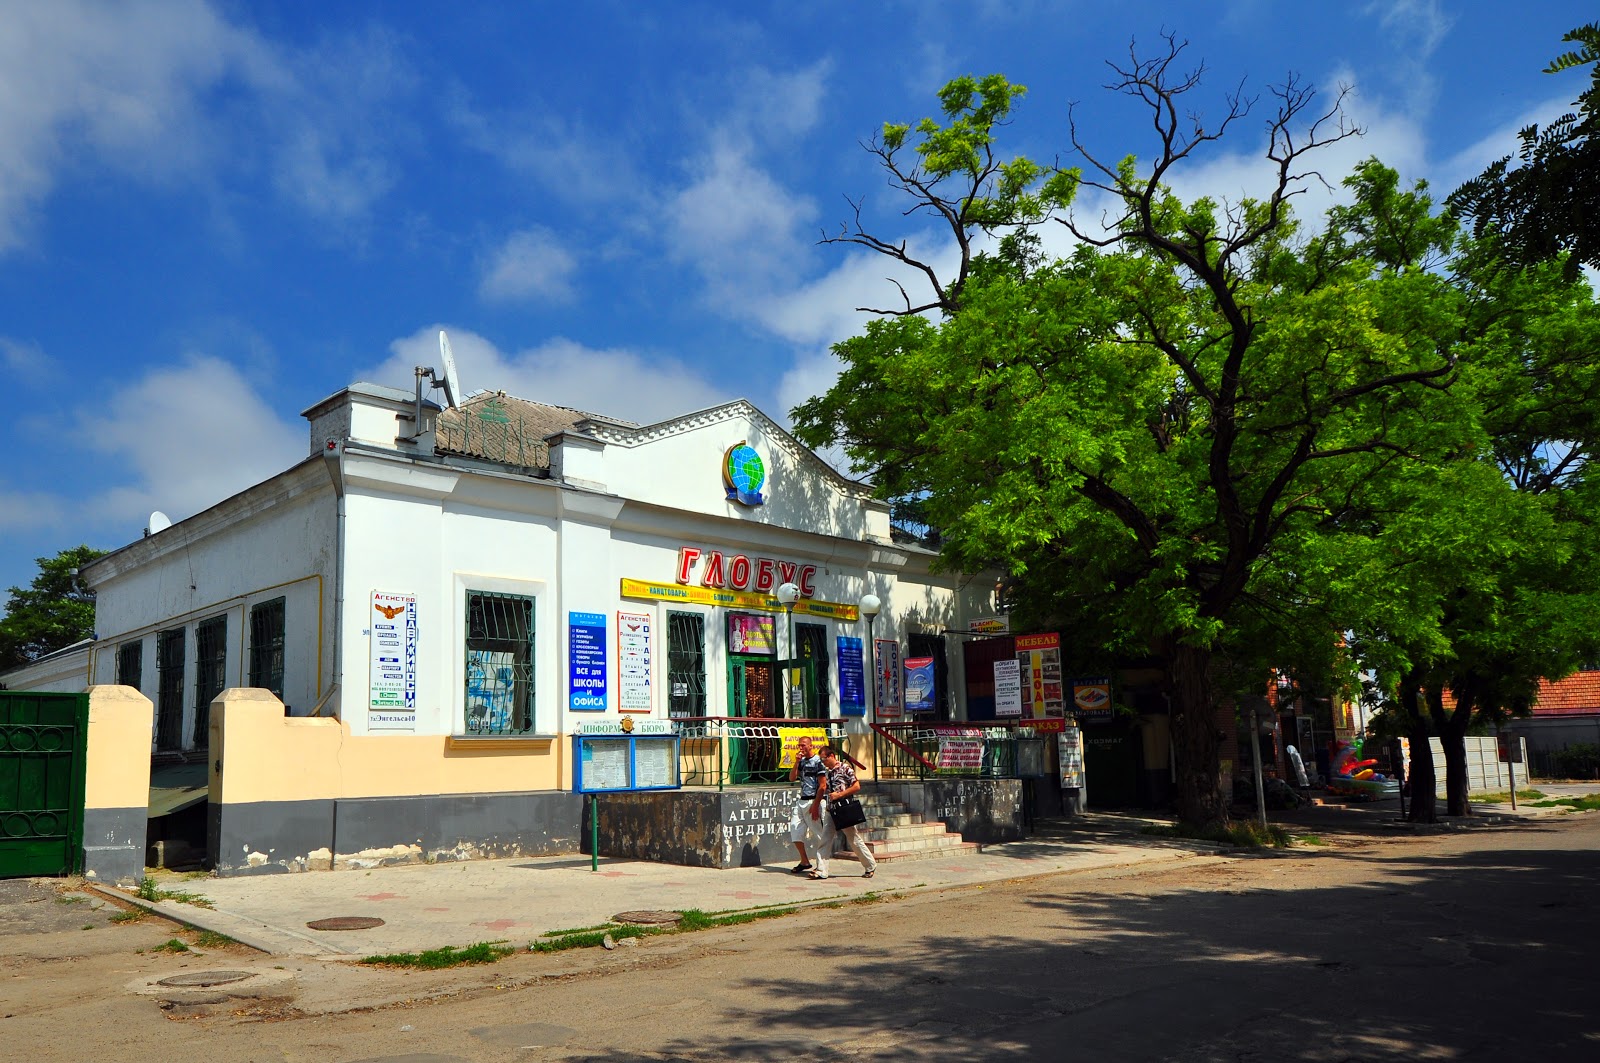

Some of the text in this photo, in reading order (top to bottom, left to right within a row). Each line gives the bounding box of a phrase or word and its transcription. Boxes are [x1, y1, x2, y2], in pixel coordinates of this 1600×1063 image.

[676, 546, 817, 598] ГЛОБУС
[649, 586, 687, 597] КАНЦТОВАРЫ
[713, 594, 734, 602] БЛАНКИ
[1016, 635, 1058, 648] МЕБЕЛЬ
[405, 603, 416, 708] НЕДВИЖИМОСТИ
[576, 667, 589, 675] ВСЕ
[891, 643, 899, 703] ПОДАРКИ
[573, 678, 605, 688] ШКОЛЫ
[573, 696, 605, 706] ОФИСА
[583, 724, 621, 733] ИНФОРМ
[641, 724, 665, 733] БЮРО
[1024, 721, 1060, 731] ЗАКАЗ
[729, 807, 799, 822] АГЕНТСТ
